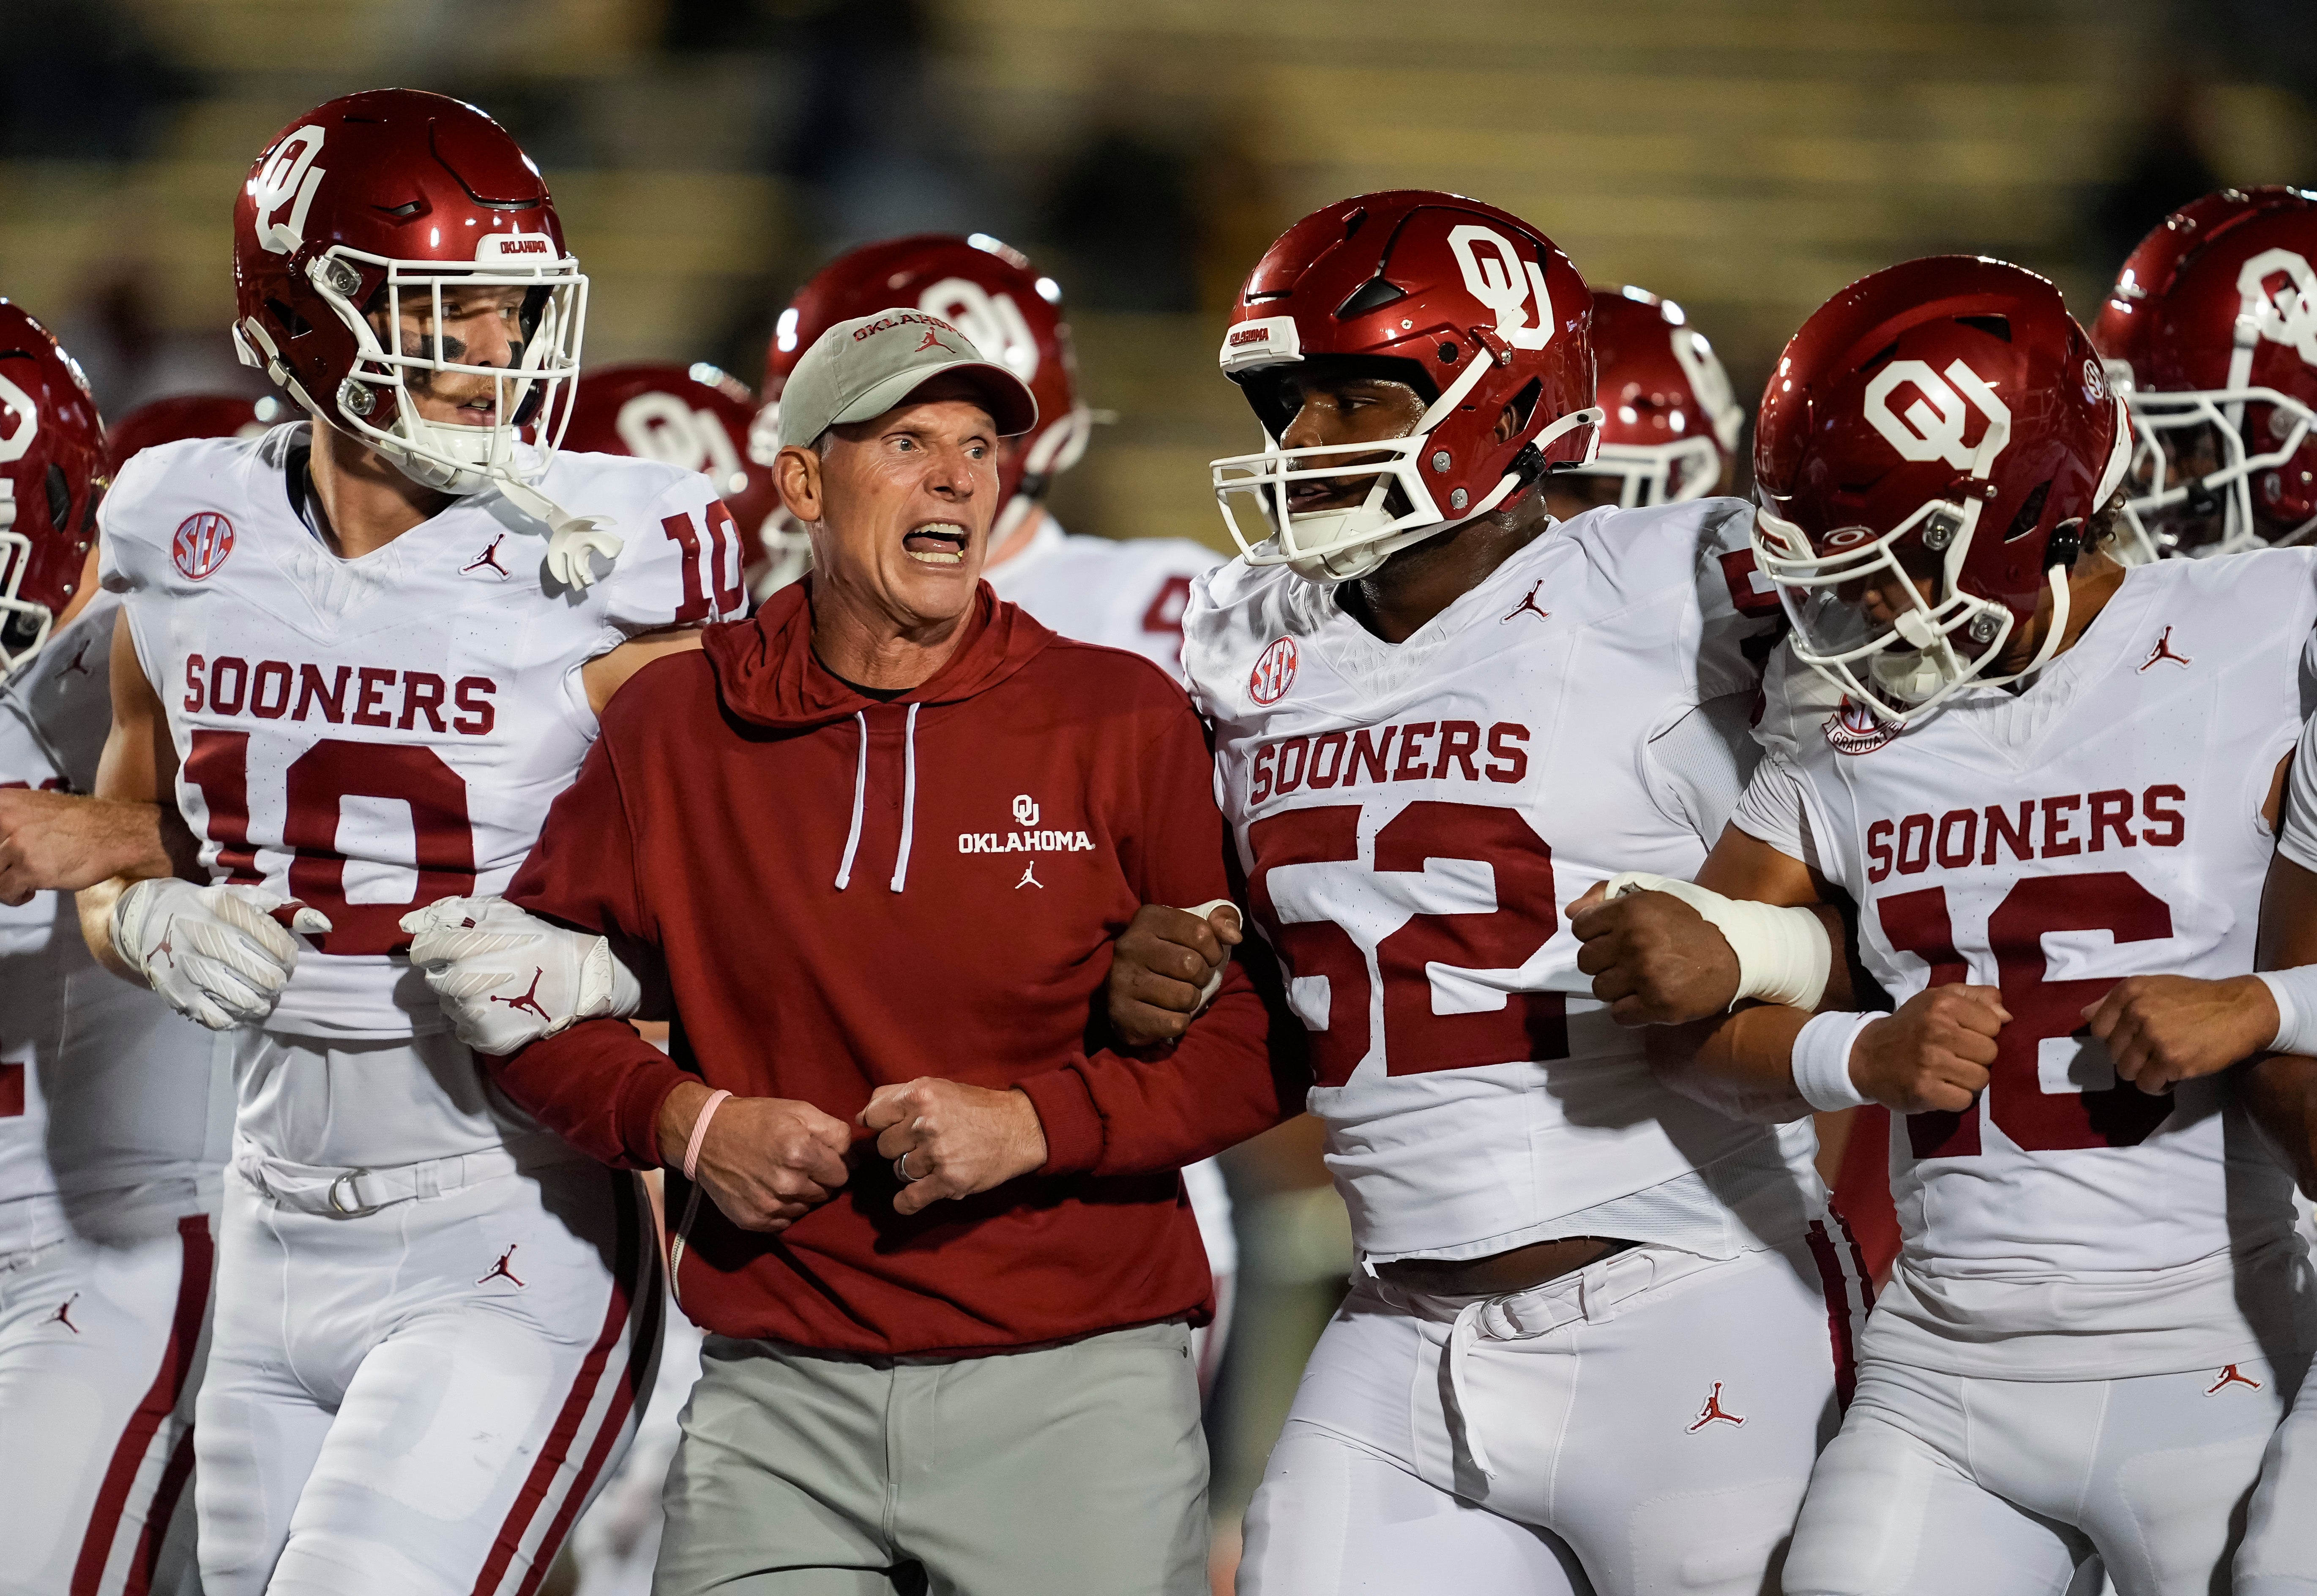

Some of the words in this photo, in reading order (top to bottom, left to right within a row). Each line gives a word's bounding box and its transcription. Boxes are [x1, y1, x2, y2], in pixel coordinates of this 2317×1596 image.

[1447, 225, 1555, 350] OU
[1863, 358, 2011, 470] OU
[177, 515, 231, 575] SEC
[661, 499, 744, 623] 10
[184, 653, 496, 735] SOONERS
[1252, 639, 1295, 700] SEC
[1250, 720, 1531, 806] SOONERS
[1833, 721, 1900, 752] GRADUATE
[184, 729, 476, 956] 10
[959, 831, 1092, 853] OKLAHOMA
[1013, 795, 1039, 826] OU
[1867, 784, 2186, 884] SOONERS
[1247, 801, 1570, 1088] 52
[1877, 871, 2175, 1159] 16
